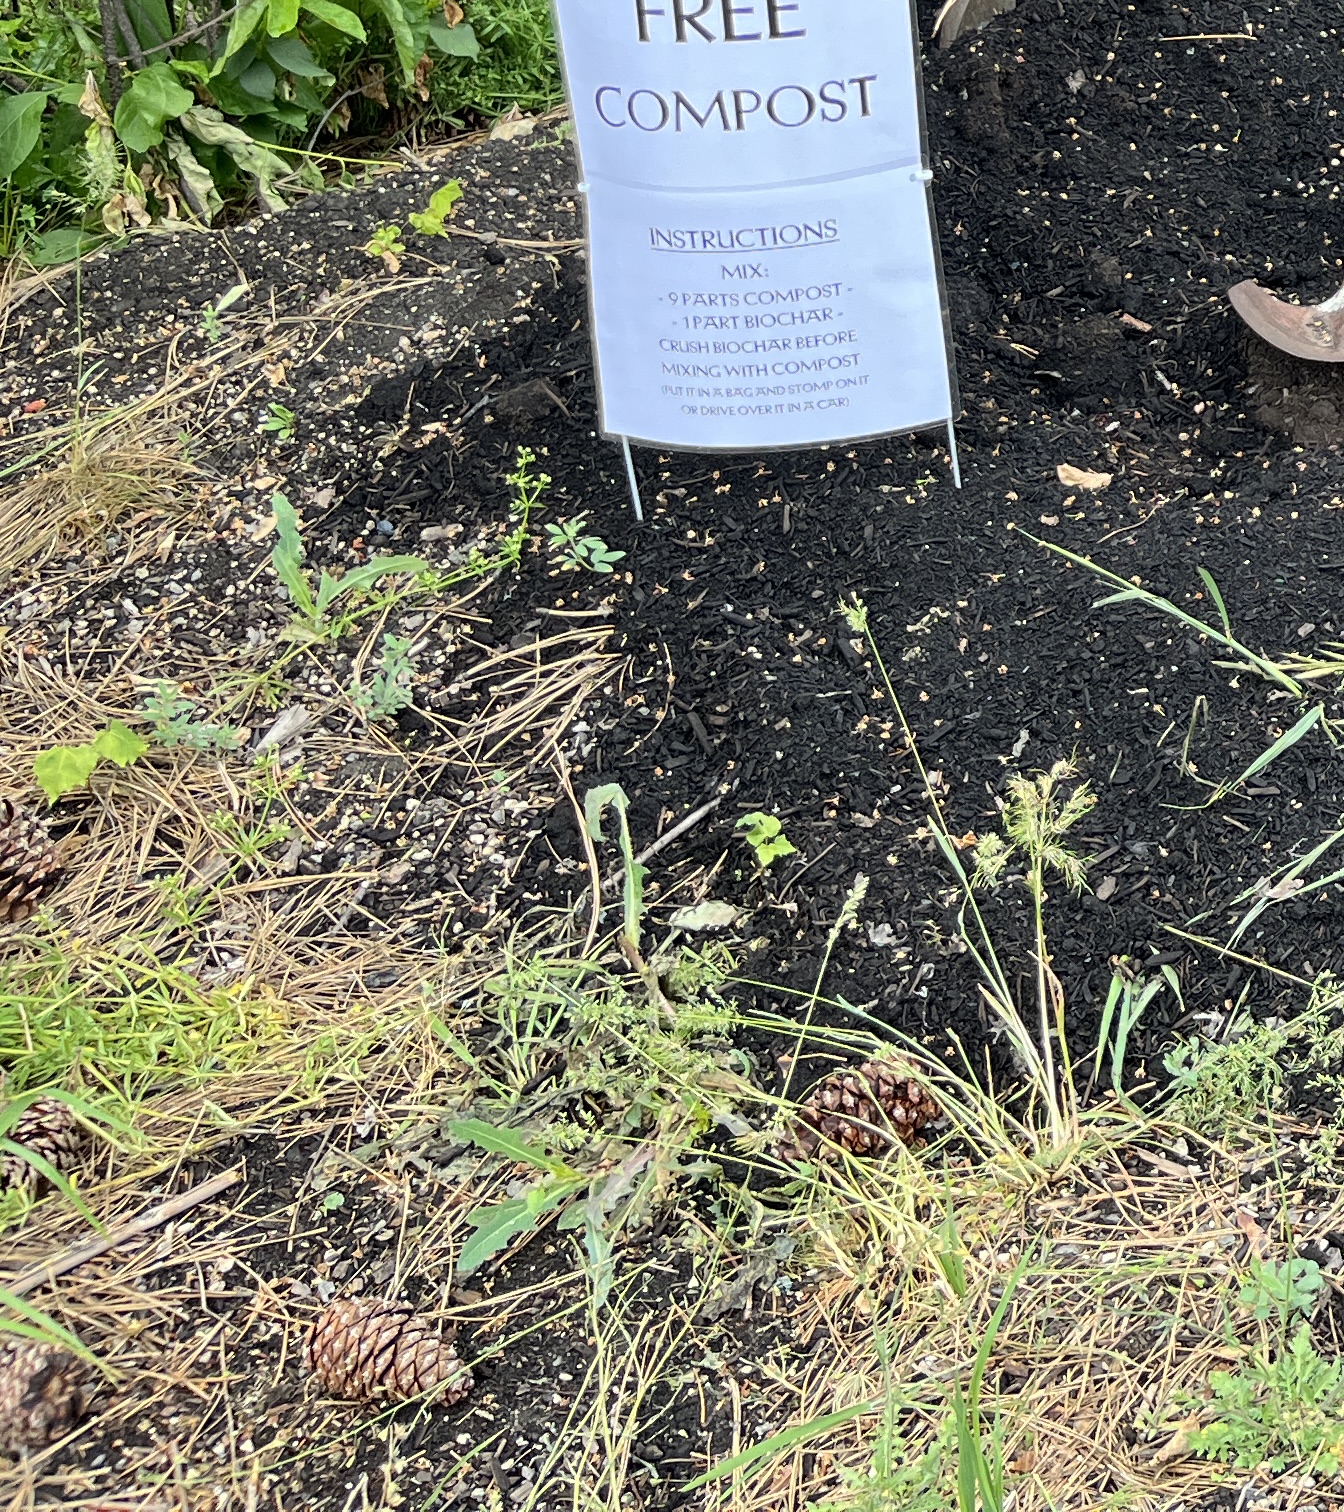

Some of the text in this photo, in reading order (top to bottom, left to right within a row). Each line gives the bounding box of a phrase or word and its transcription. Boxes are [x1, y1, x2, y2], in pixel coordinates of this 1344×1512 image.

[595, 74, 877, 132] COMPOST
[649, 219, 838, 249] INSTRUCTIONS
[721, 263, 769, 280] MIX:
[668, 292, 678, 306] 9
[682, 293, 739, 307] PARTS
[743, 283, 842, 306] COMPOST
[683, 316, 690, 329] 1
[694, 316, 740, 329] PART
[744, 307, 834, 329] BIOCHAR
[659, 329, 858, 354] CRUSH BIOCHAR BEFORE
[661, 353, 861, 377] MIXING WITH COMPOST
[661, 375, 870, 398] (PUT IT IN A BAG AND STOMP ON IT
[681, 396, 850, 416] OR DRIVE OVER IT IN A CAR)
